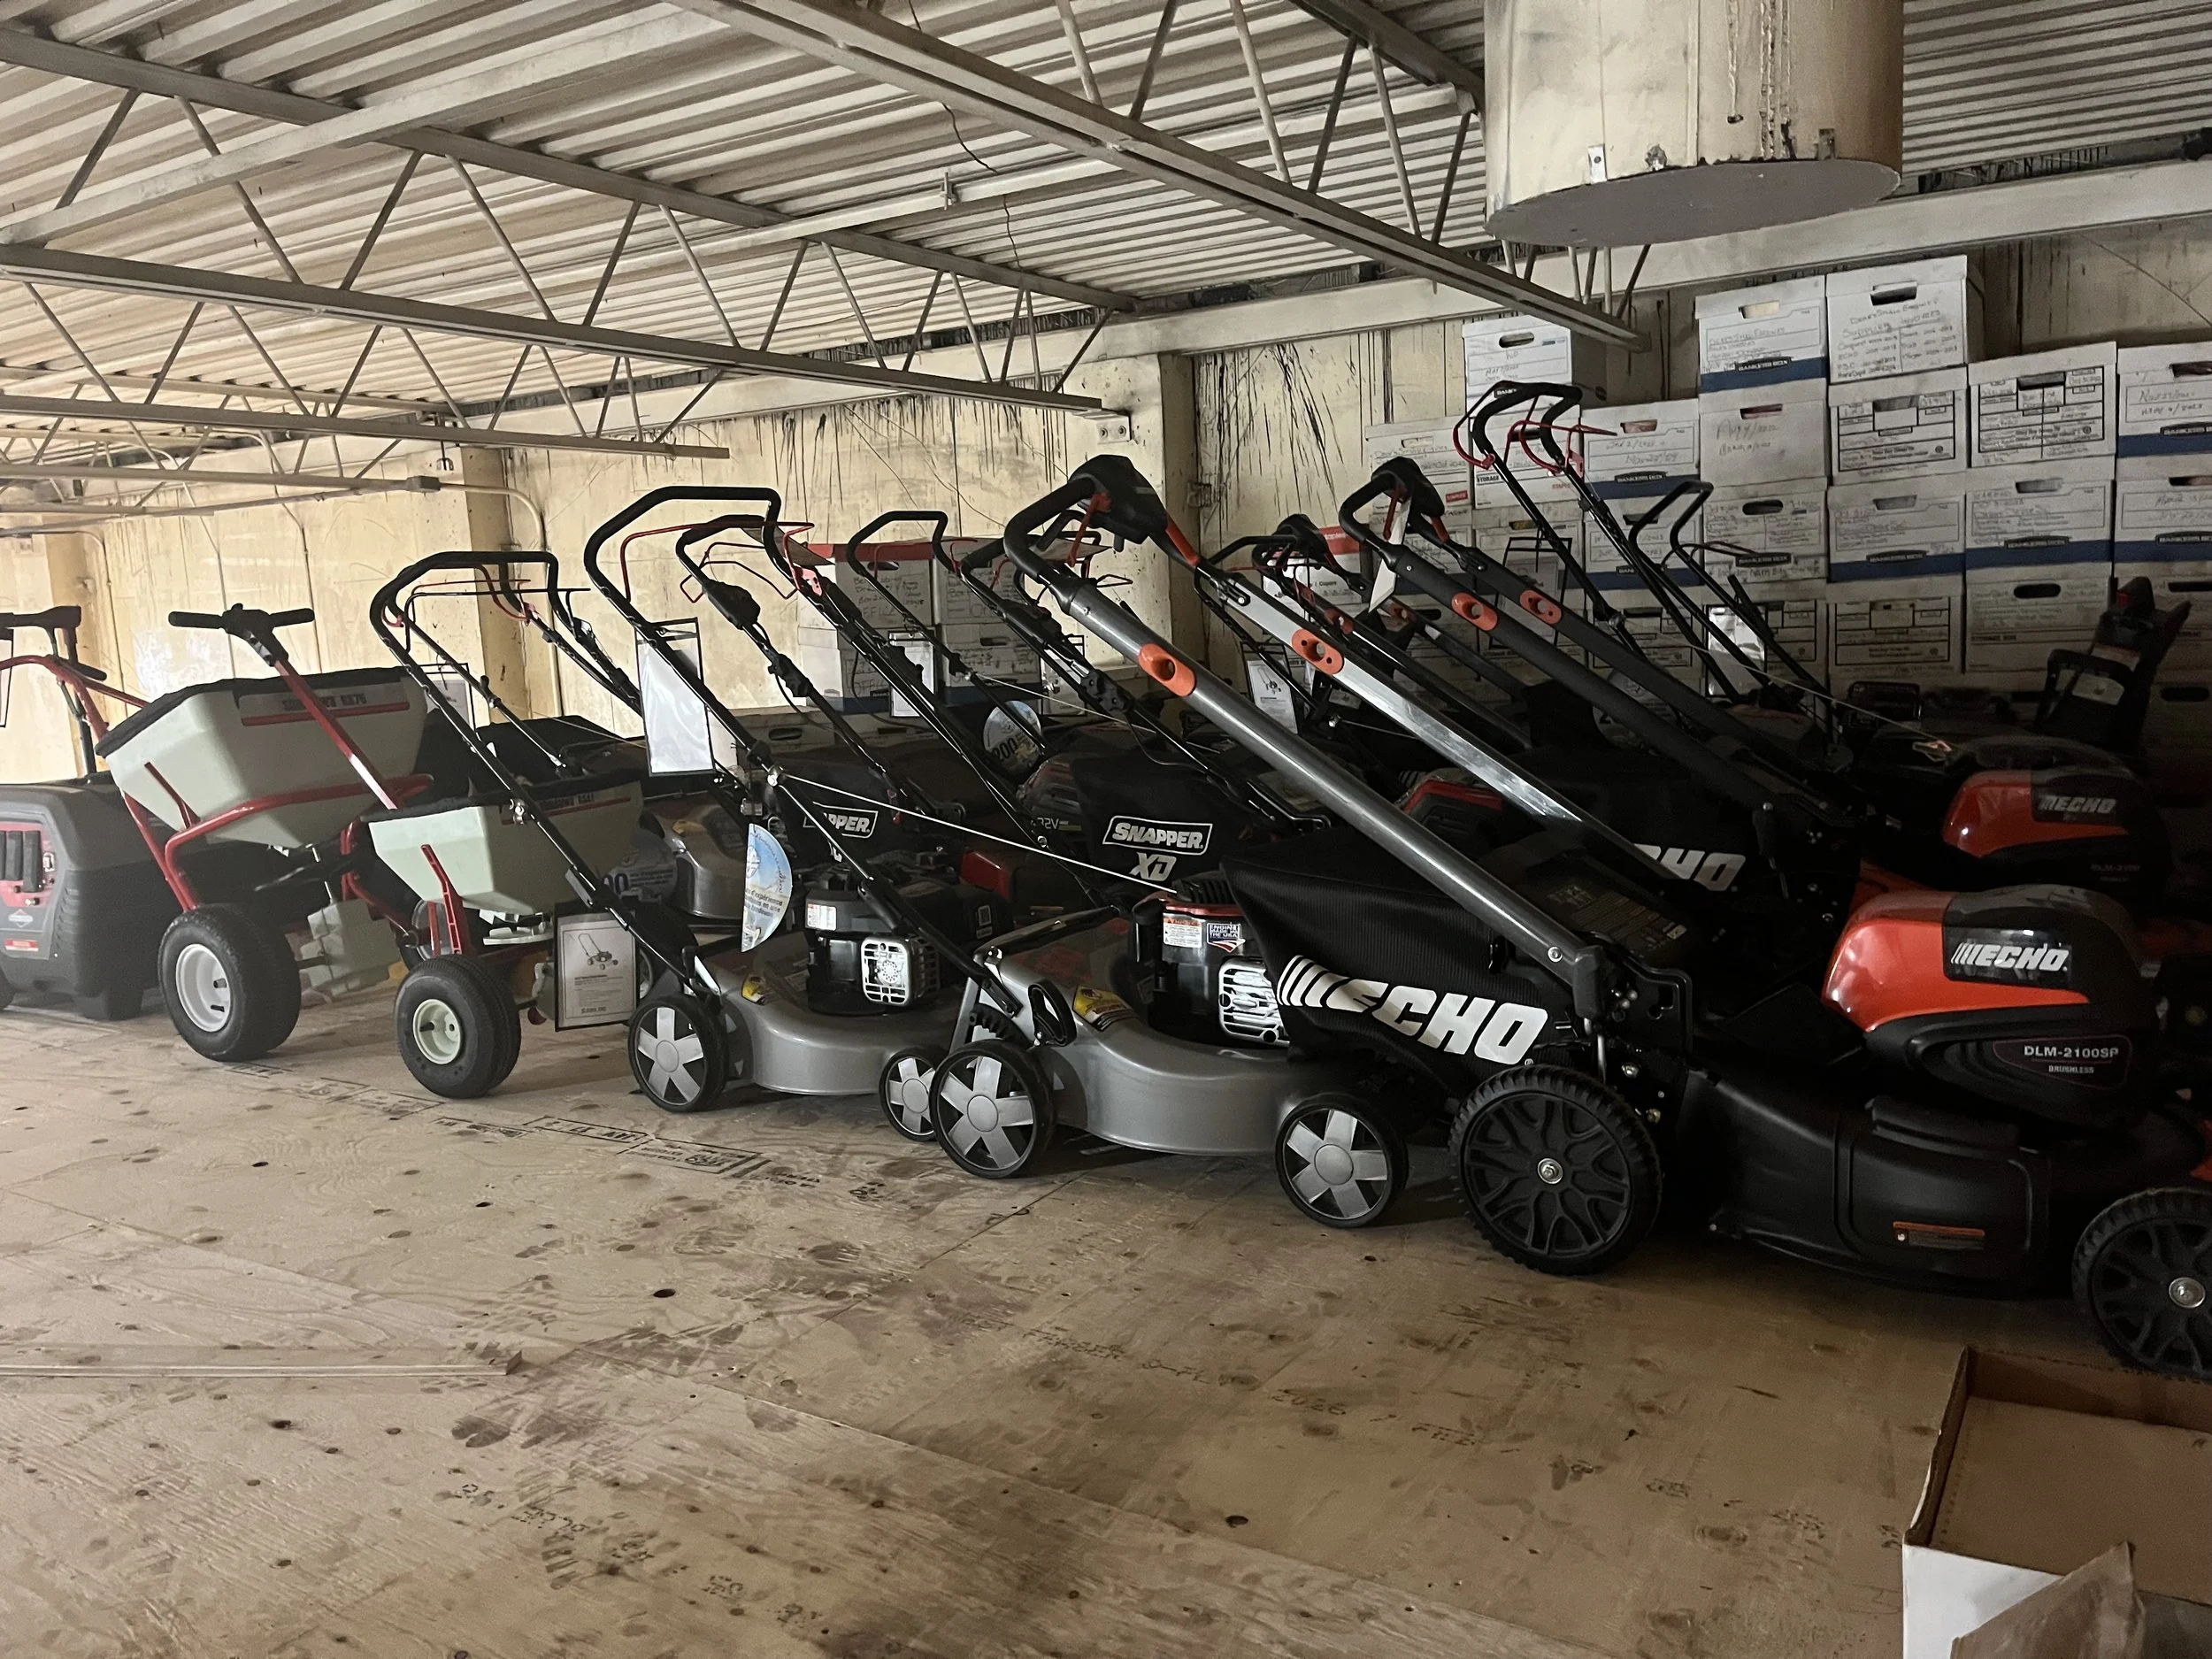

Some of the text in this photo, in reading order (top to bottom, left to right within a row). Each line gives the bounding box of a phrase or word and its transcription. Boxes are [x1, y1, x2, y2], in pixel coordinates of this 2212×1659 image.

[2049, 795, 2117, 814] ECHO
[1111, 822, 1203, 849] SNAPPER
[1129, 852, 1178, 882] XD
[1971, 943, 2070, 972] ECHO
[1322, 976, 1548, 1066] ECHO
[2024, 1045, 2119, 1059] DLM-2100SP
[2048, 1064, 2095, 1074] BRUSHLESS
